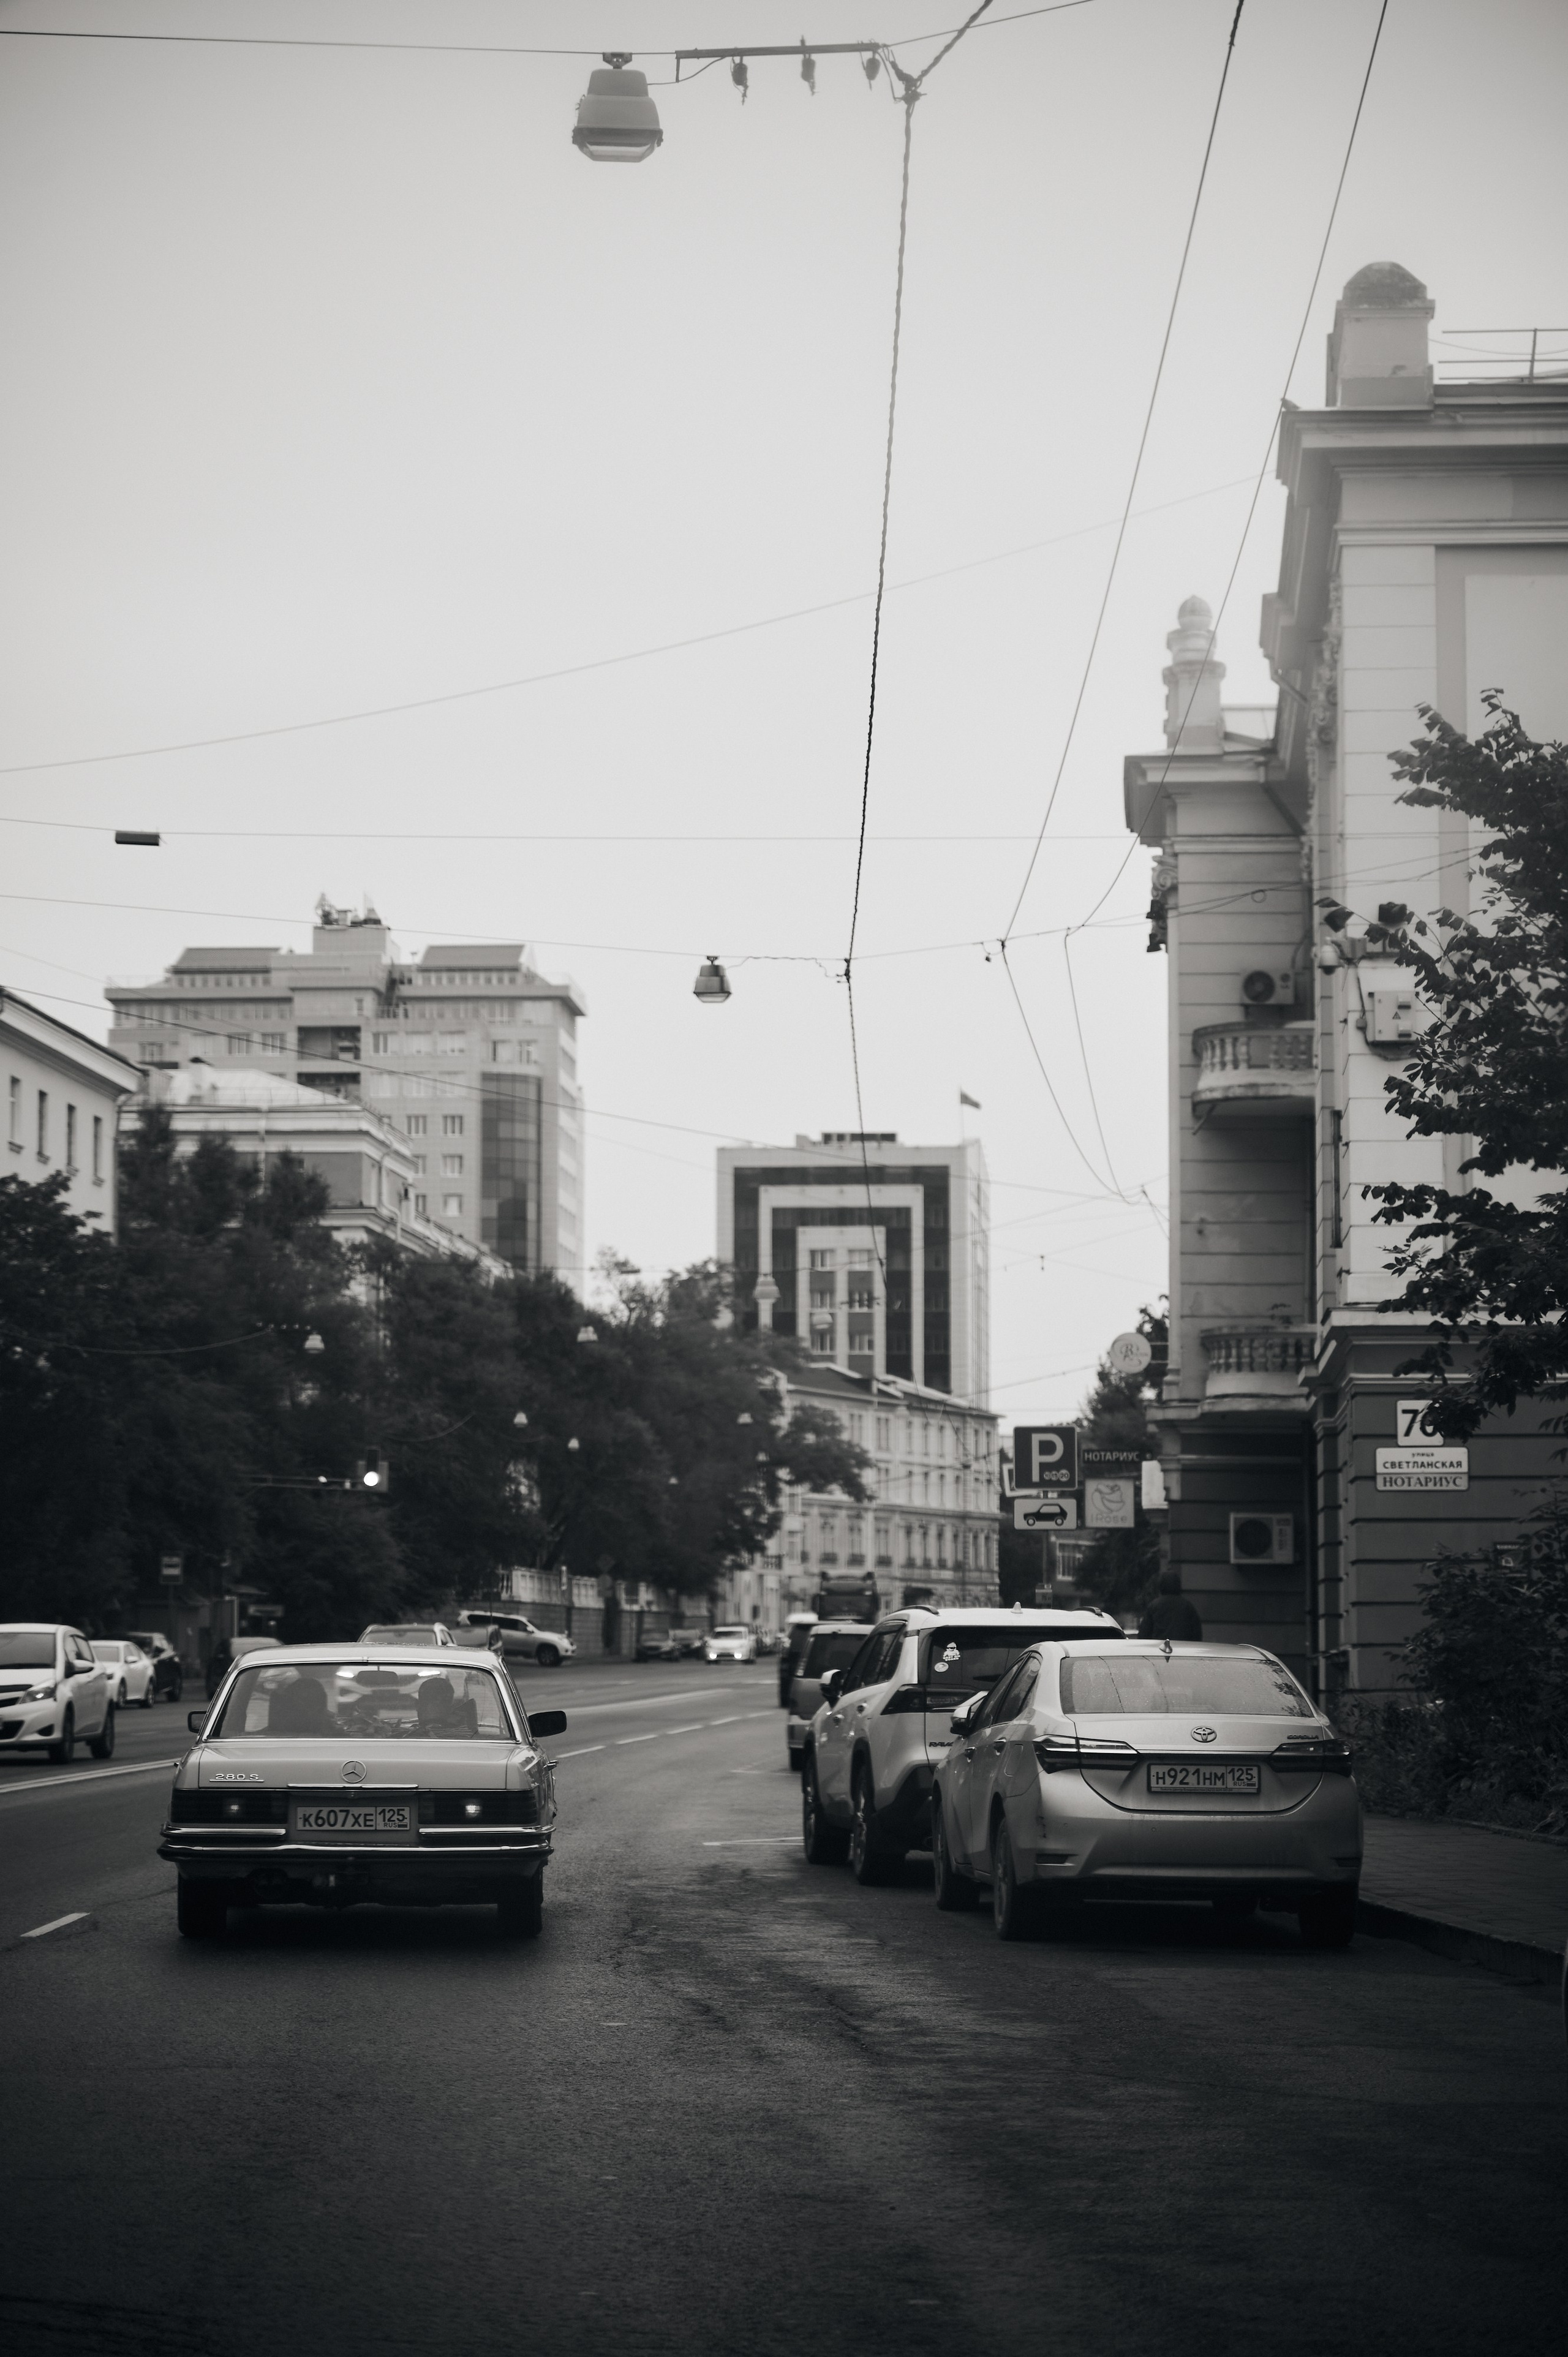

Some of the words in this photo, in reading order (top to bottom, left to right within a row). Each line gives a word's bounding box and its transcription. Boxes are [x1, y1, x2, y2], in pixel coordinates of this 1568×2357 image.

[1031, 1433, 1064, 1482] P
[1084, 1451, 1140, 1461] НОТАРИУС
[1382, 1460, 1463, 1469] СВЕТЛАНСКАЯ
[1382, 1476, 1463, 1488] НОТАРИУС
[1228, 1768, 1253, 1781] 125
[378, 1808, 405, 1822] 125
